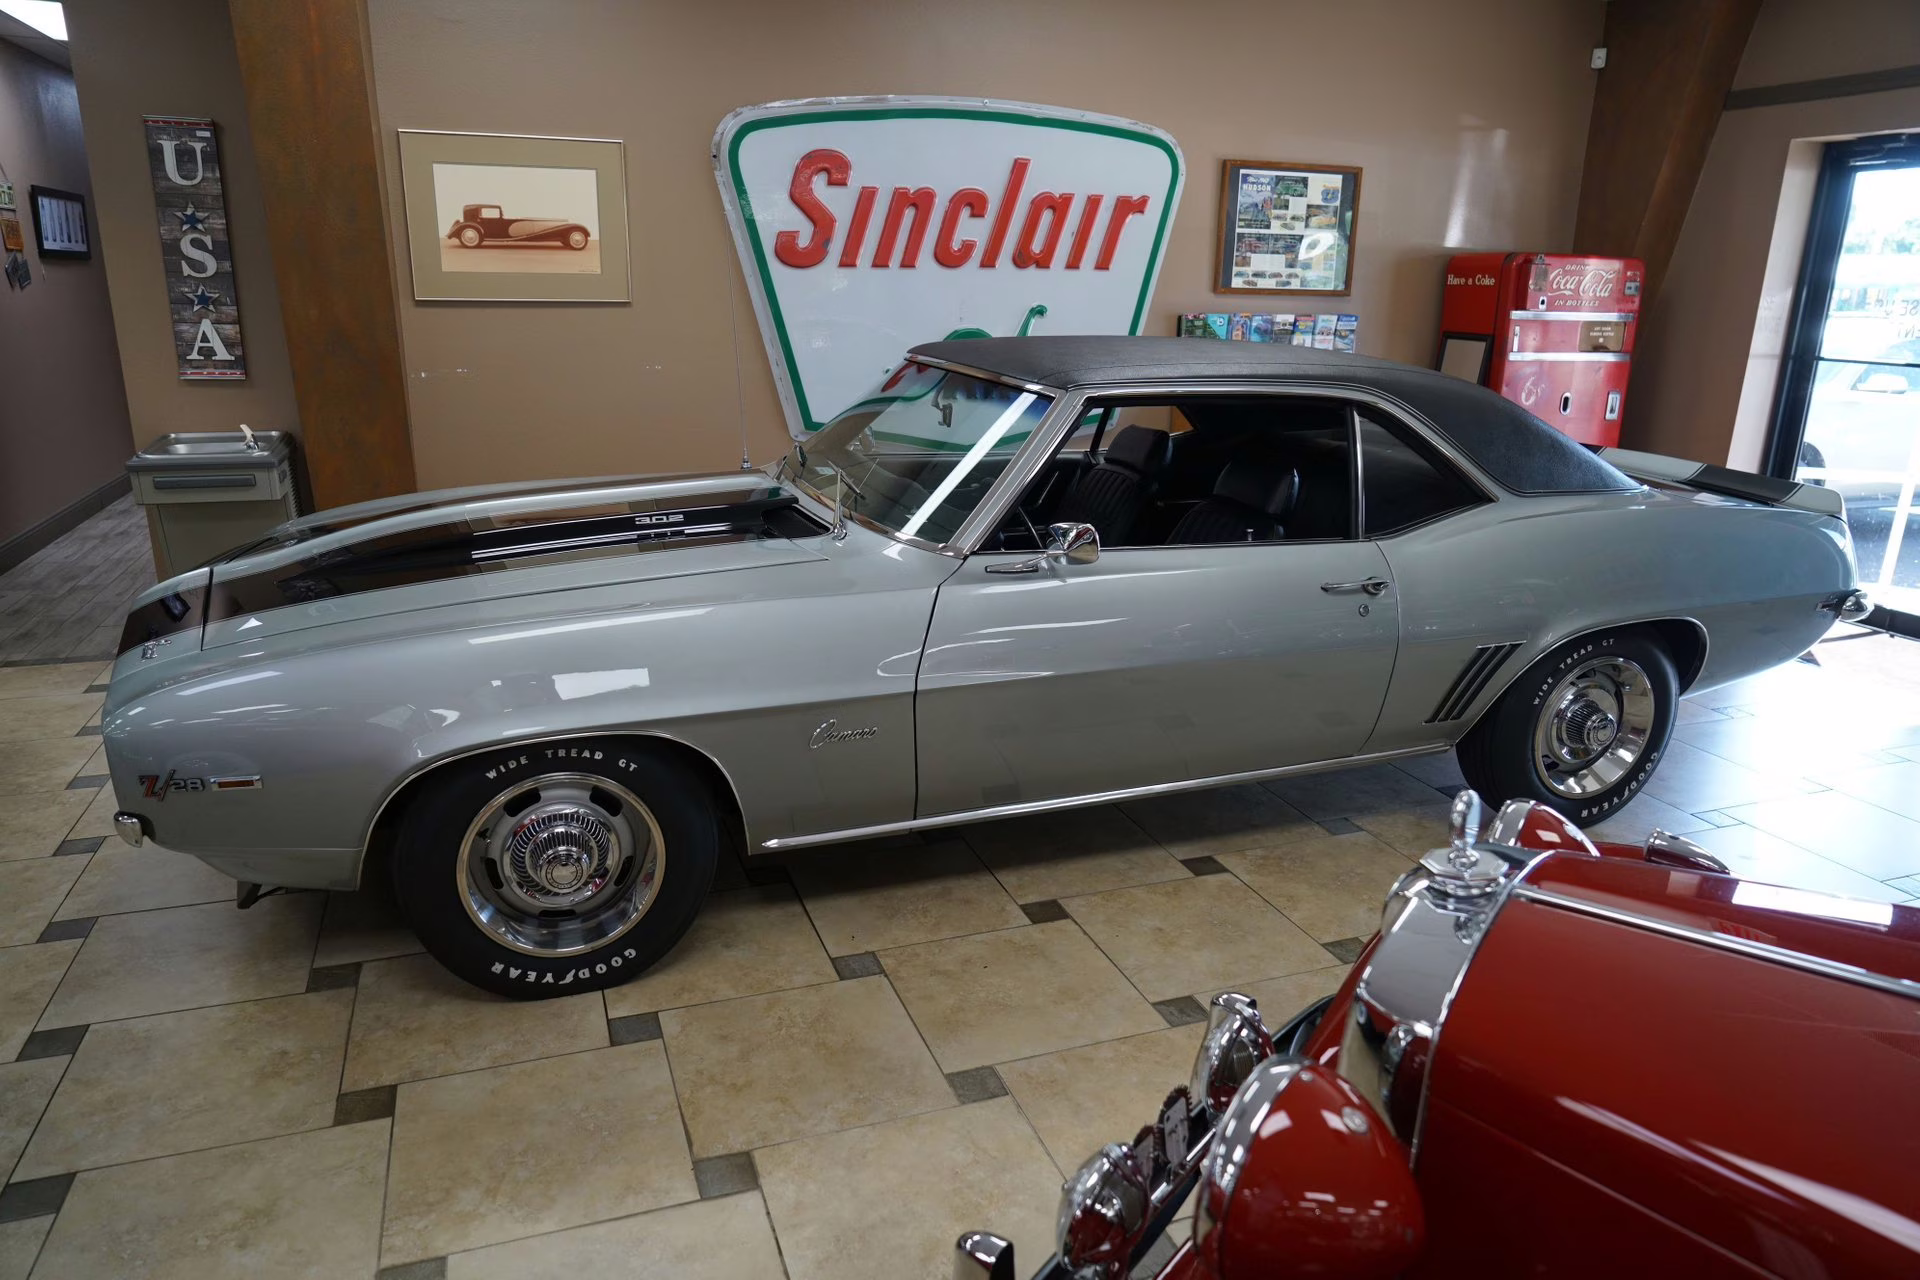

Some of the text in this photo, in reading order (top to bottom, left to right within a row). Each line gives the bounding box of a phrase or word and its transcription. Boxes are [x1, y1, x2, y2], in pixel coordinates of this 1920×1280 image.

[1243, 183, 1271, 192] HUDSON
[774, 148, 1150, 271] Sinclair
[157, 140, 236, 361] USA
[1447, 274, 1495, 286] Have a Coke
[1566, 299, 1600, 307] BOTTLES
[635, 514, 685, 525] 302
[1533, 638, 1615, 706] WIDE TREAD GT
[810, 719, 878, 748] Camaro
[485, 748, 638, 780] WIDE TREAD GT
[138, 769, 206, 802] Z/28
[490, 947, 637, 985] GOODYEAR
